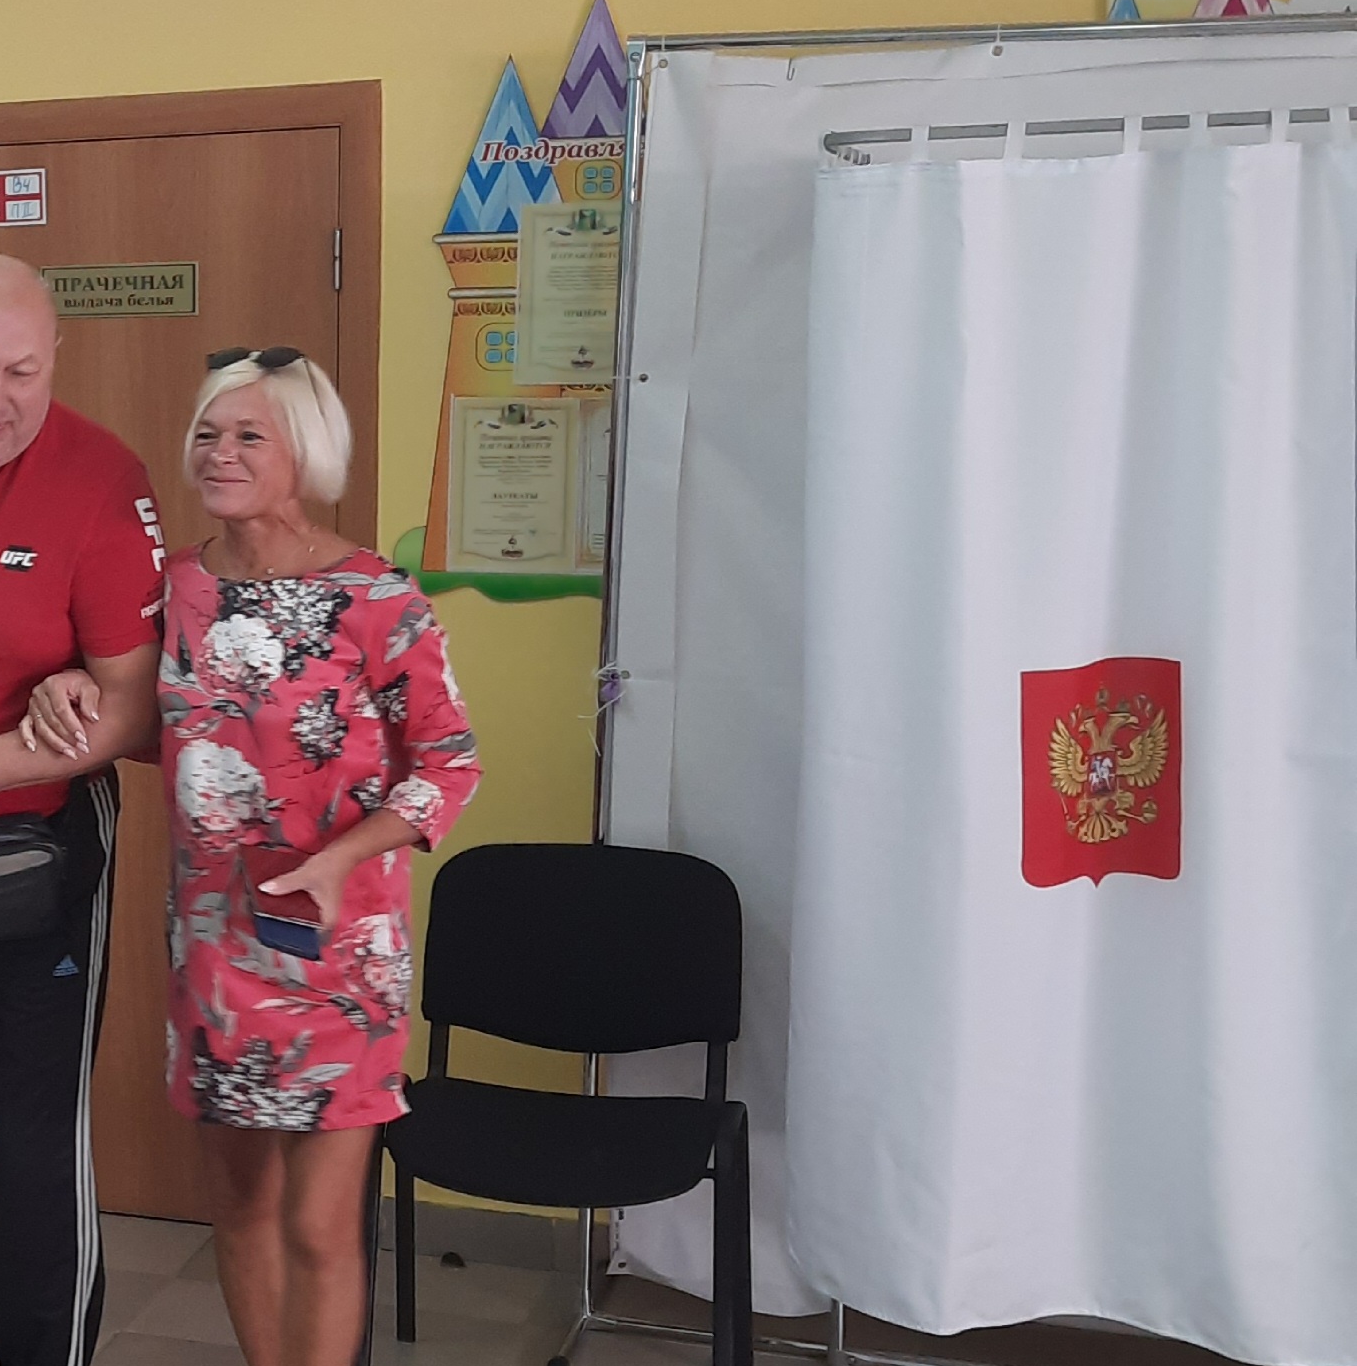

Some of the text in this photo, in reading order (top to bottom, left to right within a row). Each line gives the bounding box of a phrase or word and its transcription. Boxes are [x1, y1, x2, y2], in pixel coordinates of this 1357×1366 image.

[52, 273, 185, 294] ПРАЧЕЧНАЯ
[63, 293, 174, 309] выдача белья
